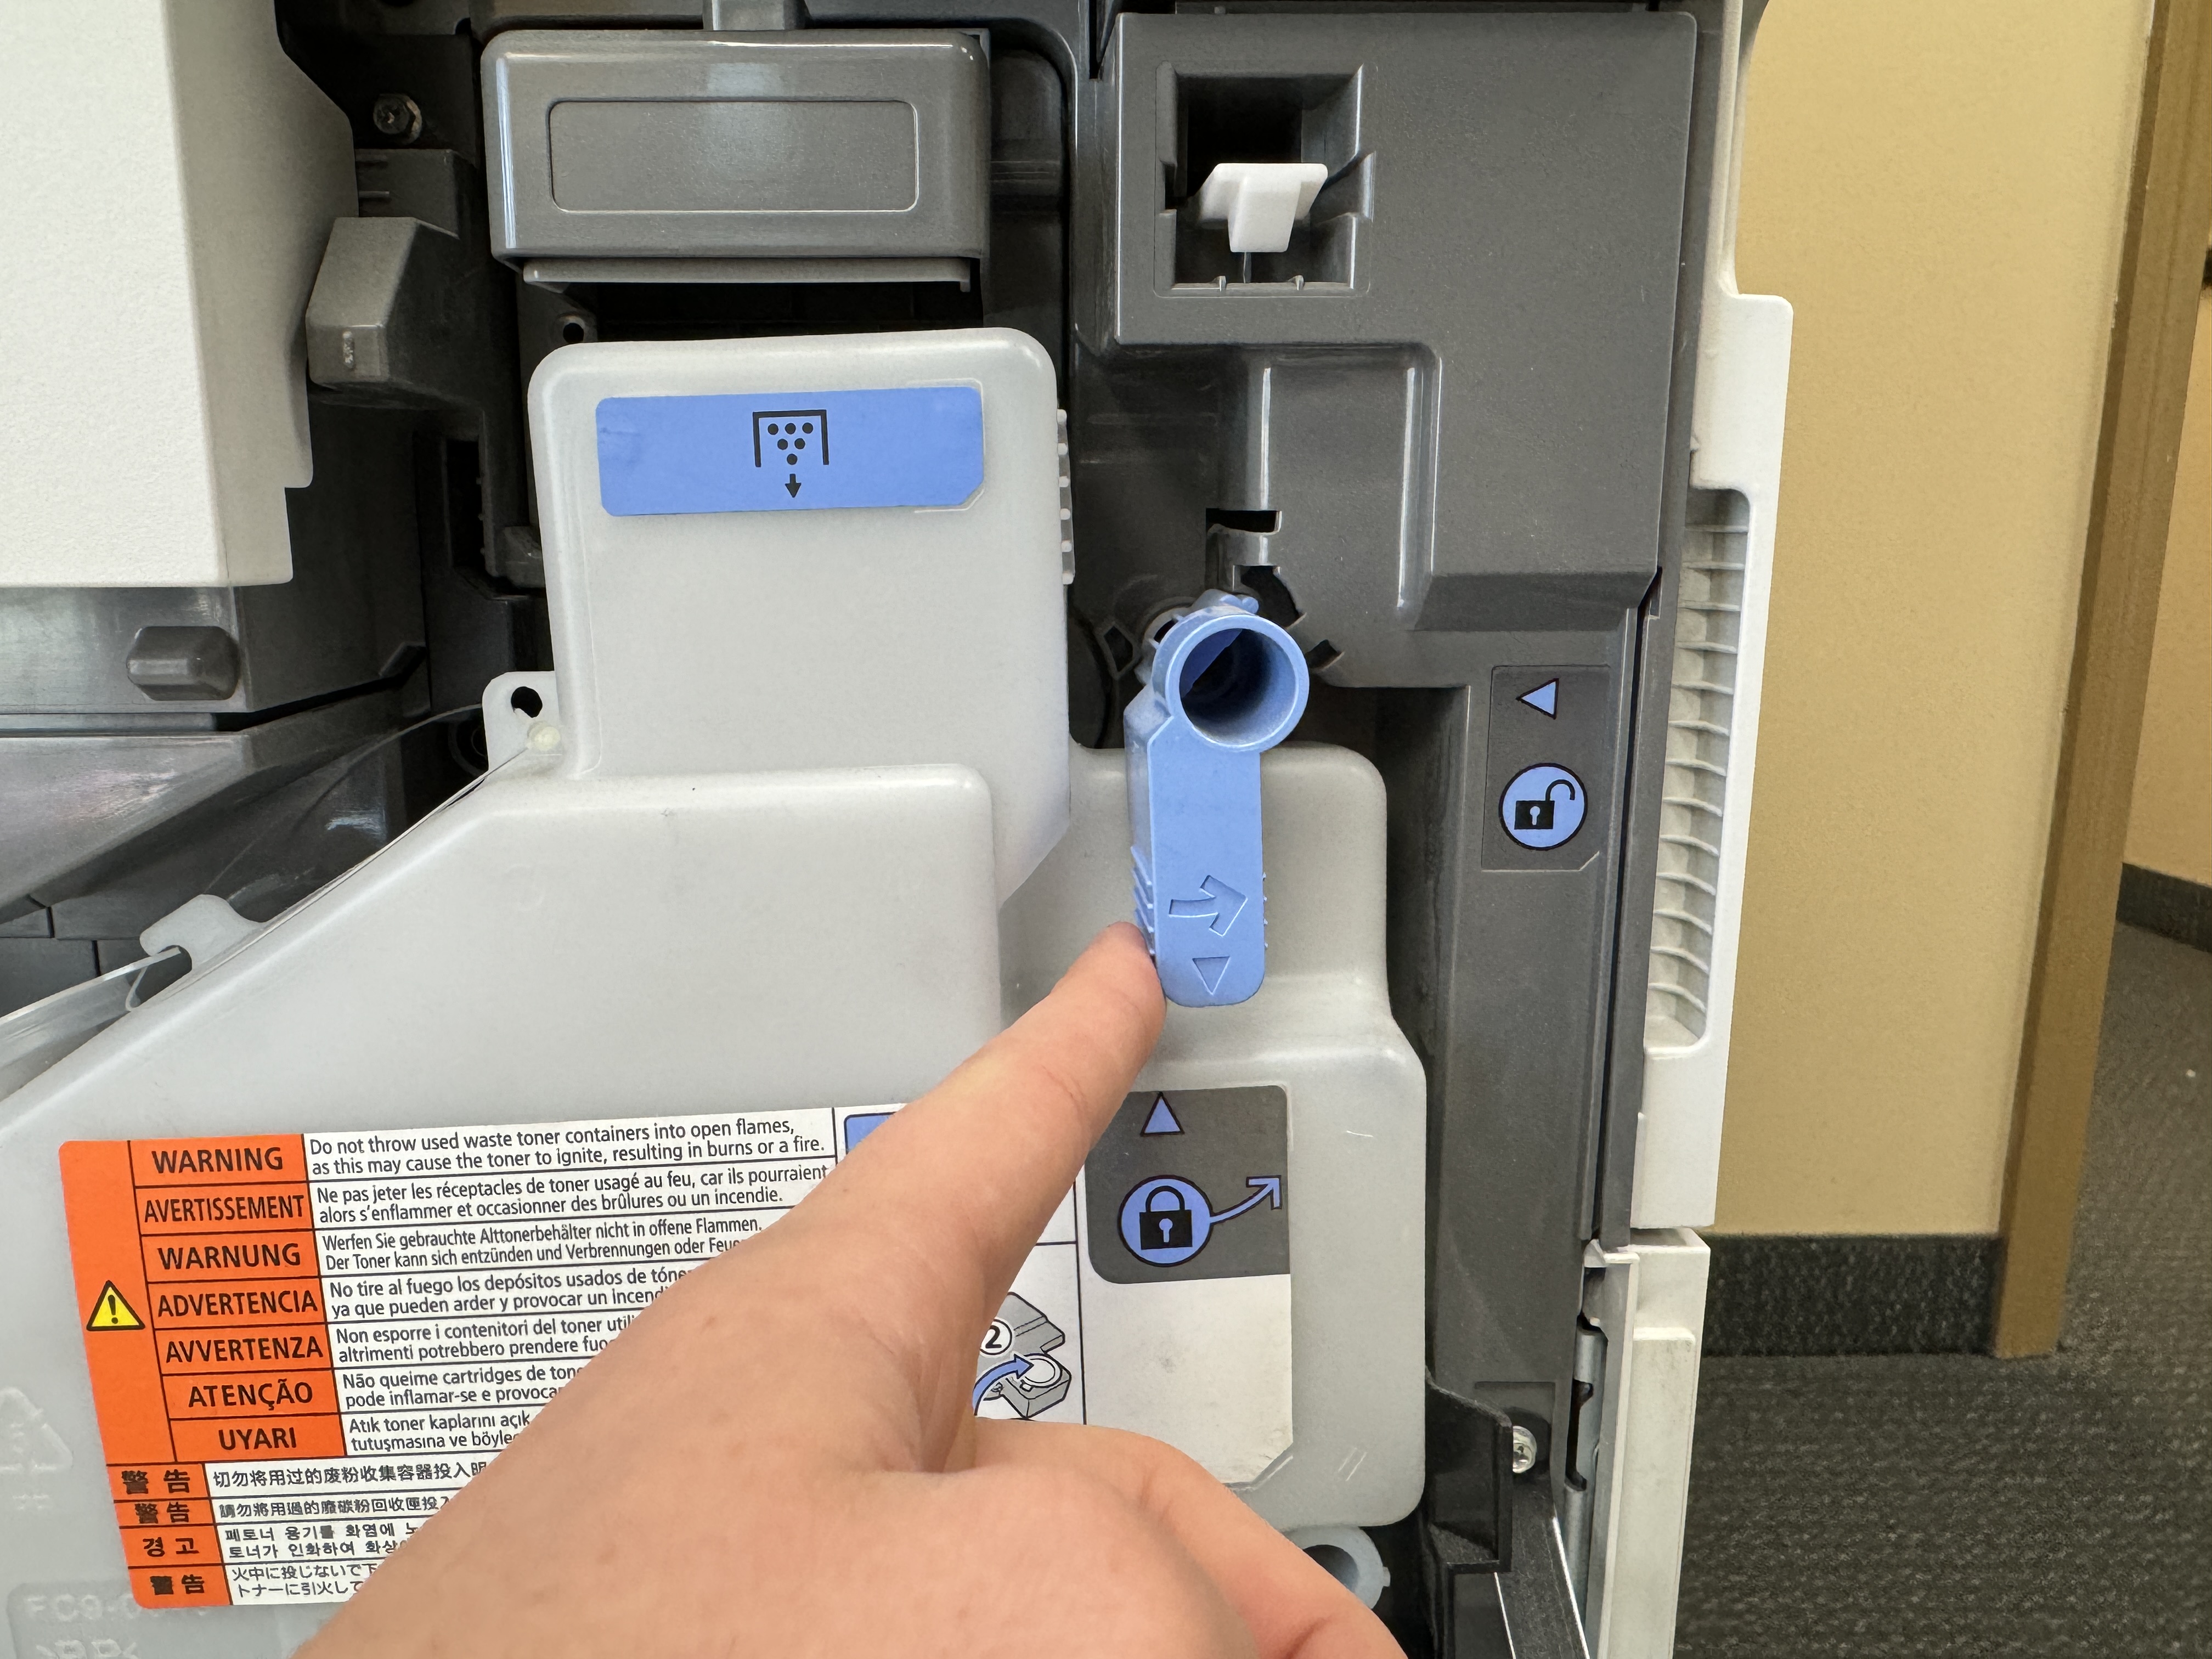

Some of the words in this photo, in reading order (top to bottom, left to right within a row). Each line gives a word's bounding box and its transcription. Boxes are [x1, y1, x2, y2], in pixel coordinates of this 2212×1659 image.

[310, 1139, 332, 1155] Do
[337, 1138, 365, 1154] not
[368, 1135, 416, 1153] throw
[421, 1131, 459, 1150] used
[463, 1132, 512, 1148] waste
[516, 1132, 560, 1146] toner
[565, 1125, 650, 1144] containers
[654, 1122, 686, 1139] into
[691, 1124, 731, 1140] open
[736, 1118, 794, 1135] flames,
[152, 1148, 283, 1173] WARNING
[312, 1163, 330, 1175] as
[333, 1157, 363, 1175] this
[368, 1159, 401, 1175] may
[406, 1157, 452, 1171] cause
[455, 1152, 483, 1169] the
[487, 1153, 531, 1167] toner
[534, 1151, 552, 1165] to
[556, 1147, 607, 1166] ignite,
[613, 1143, 682, 1161] resulting
[687, 1141, 702, 1158] in
[707, 1140, 753, 1157] burns
[758, 1142, 774, 1154] or
[779, 1141, 789, 1153] a
[793, 1135, 825, 1152] fire.
[317, 1187, 338, 1204] Ne
[342, 1189, 369, 1205] pas
[373, 1184, 407, 1204] jeter
[411, 1182, 432, 1199] les
[436, 1178, 522, 1200] réceptacles
[526, 1177, 545, 1194] de
[548, 1178, 590, 1193] toner
[594, 1172, 640, 1192] usagé
[644, 1176, 663, 1188] au
[667, 1170, 695, 1189] feu,
[700, 1172, 724, 1186] car
[727, 1167, 744, 1184] ils
[748, 1164, 828, 1187] pourraient
[145, 1195, 303, 1222] AVERTISSEMENT
[320, 1206, 356, 1223] alors
[457, 1203, 473, 1217] et
[476, 1198, 566, 1216] occasionner
[571, 1195, 597, 1212] des
[601, 1192, 664, 1210] brûlures
[667, 1194, 686, 1207] ou
[691, 1193, 710, 1206] un
[714, 1186, 783, 1205] incendie.
[321, 1233, 373, 1251] Werfen
[375, 1232, 396, 1249] Sie
[399, 1228, 476, 1250] gebrauchte
[479, 1223, 592, 1244] Alttonerbehälter
[596, 1221, 630, 1239] nicht
[632, 1221, 645, 1237] in
[649, 1218, 692, 1236] offene
[696, 1217, 762, 1234] Flammen.
[157, 1243, 300, 1269] WARNUNG
[325, 1255, 349, 1270] Der
[352, 1254, 391, 1269] Toner
[394, 1251, 428, 1268] kann
[431, 1249, 458, 1266] sich
[461, 1245, 533, 1265] entzünden
[537, 1243, 562, 1261] und
[565, 1242, 670, 1260] Verbrennungen
[674, 1237, 705, 1254] oder
[330, 1282, 353, 1298] No
[357, 1280, 384, 1296] tire
[388, 1278, 402, 1295] al
[406, 1278, 453, 1296] fuego
[457, 1276, 481, 1292] los
[484, 1272, 562, 1293] depósitos
[566, 1269, 623, 1287] usados
[627, 1267, 647, 1284] de
[651, 1266, 691, 1283] tóne
[159, 1290, 317, 1317] ADVERTENCIA
[331, 1305, 350, 1319] ya
[354, 1303, 385, 1319] que
[389, 1296, 449, 1317] pueden
[454, 1294, 495, 1311] arder
[499, 1297, 508, 1312] y
[513, 1294, 583, 1311] provocar
[588, 1293, 607, 1305] un
[612, 1285, 668, 1305] incen
[336, 1328, 369, 1344] Non
[373, 1328, 431, 1344] esporre
[435, 1323, 440, 1339] i
[444, 1319, 528, 1339] contenitori
[533, 1318, 556, 1335] del
[560, 1319, 602, 1334] toner
[607, 1314, 635, 1331] util
[985, 1325, 1002, 1348] 2
[167, 1336, 323, 1363] AVVERTENZA
[339, 1344, 414, 1363] altrimenti
[418, 1340, 505, 1362] potrebbero
[509, 1337, 578, 1357] prendere
[582, 1335, 608, 1352] fuo
[342, 1373, 375, 1389] Não
[380, 1370, 438, 1390] queime
[443, 1366, 522, 1385] cartridges
[526, 1364, 546, 1381] de
[549, 1365, 583, 1380] ton
[189, 1379, 312, 1410] ATENÇÃO
[346, 1390, 385, 1410] pode
[389, 1389, 477, 1406] inflamar-se
[482, 1390, 491, 1401] e
[495, 1387, 560, 1404] provoca
[349, 1417, 381, 1434] Atık
[383, 1418, 425, 1432] toner
[429, 1413, 495, 1432] kaplarını
[500, 1409, 530, 1429] açık
[219, 1427, 296, 1450] UYARI
[351, 1436, 445, 1452] tutuşmasına
[449, 1435, 467, 1447] ve
[471, 1429, 519, 1448] böyle
[346, 1523, 395, 1538] 화염에
[229, 1544, 278, 1559] 토너가
[288, 1541, 355, 1557] 인화하여
[365, 1540, 408, 1554] 화상
[232, 1563, 377, 1581] 火中に投じないで下
[238, 1581, 364, 1598] トナーに引火して
